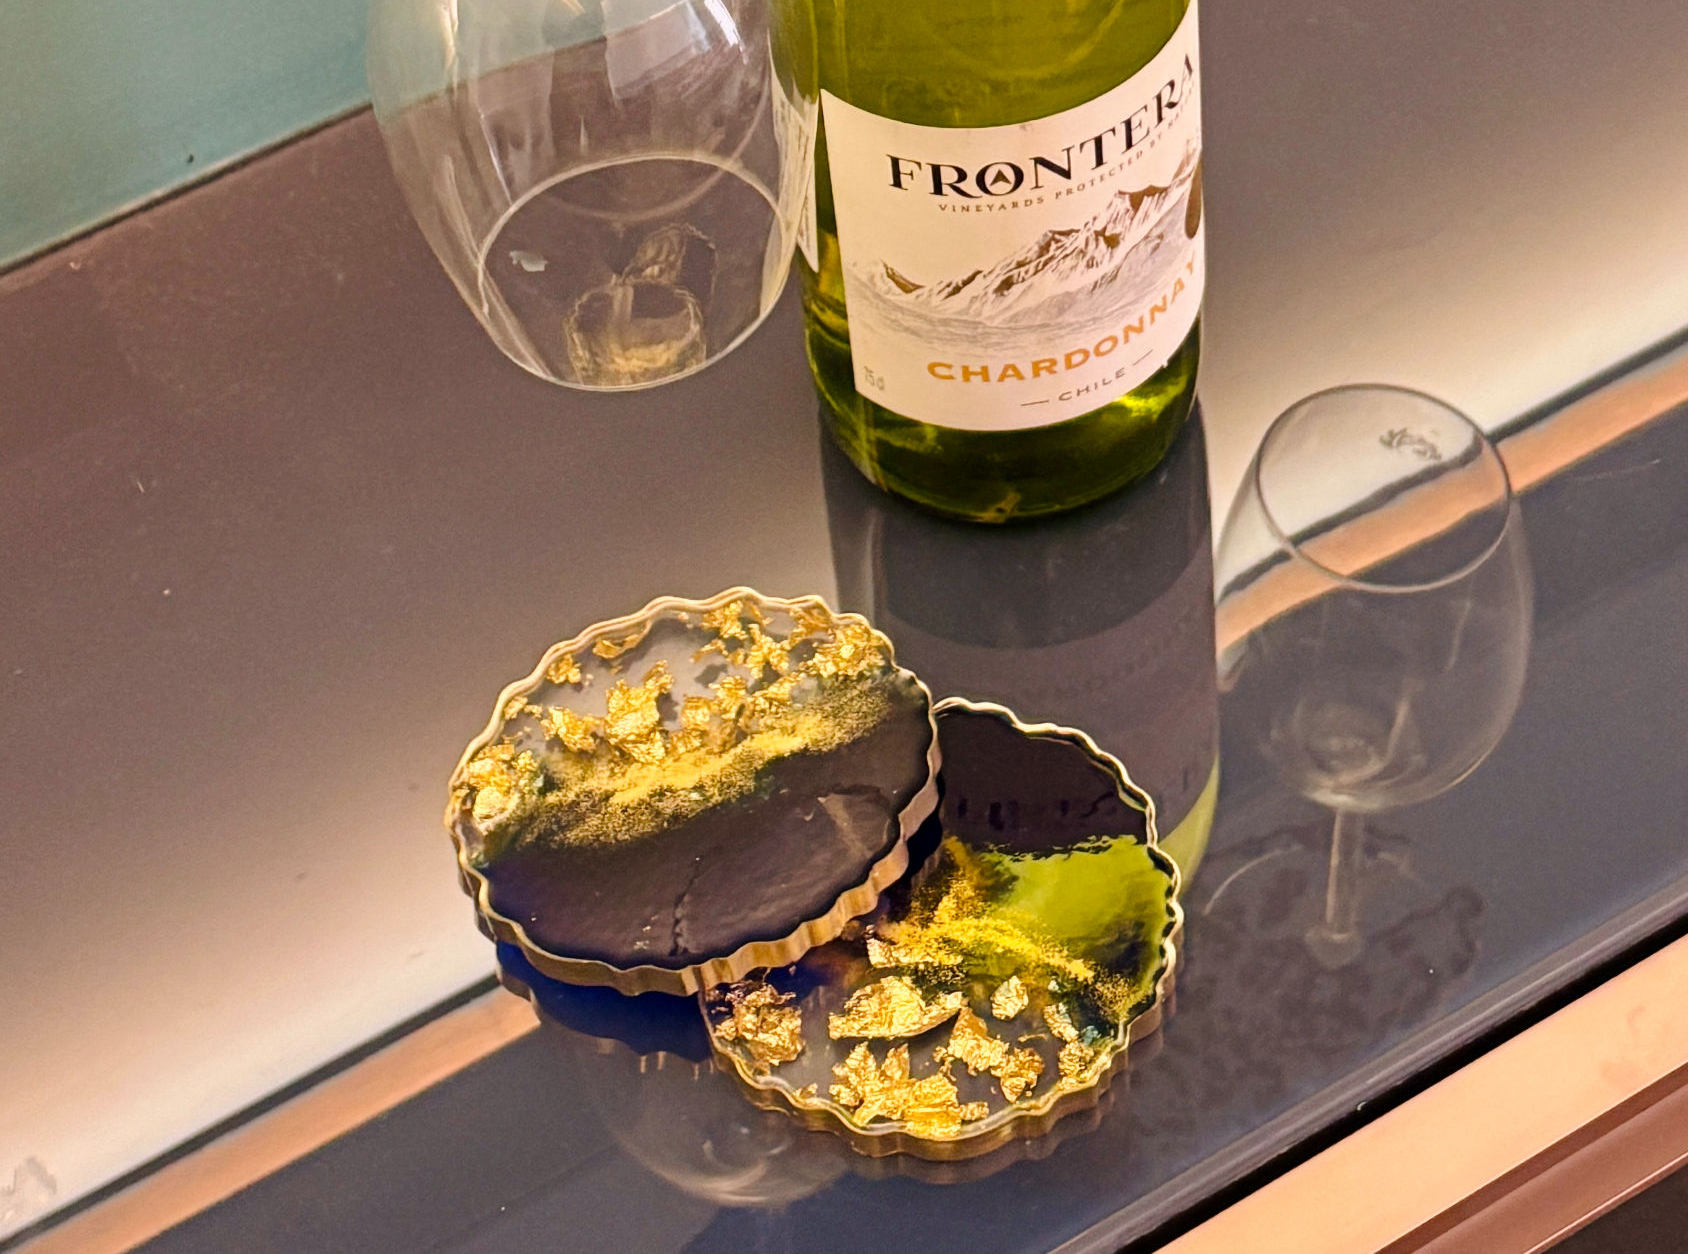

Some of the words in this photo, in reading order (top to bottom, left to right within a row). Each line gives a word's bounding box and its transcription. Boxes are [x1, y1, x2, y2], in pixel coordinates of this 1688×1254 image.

[886, 53, 1194, 200] FRONTERA
[938, 196, 1045, 213] VINEYARDS
[1054, 149, 1144, 200] PROTECTED
[926, 249, 1195, 382] CHARDONNAY
[1057, 366, 1126, 402] CHILE
